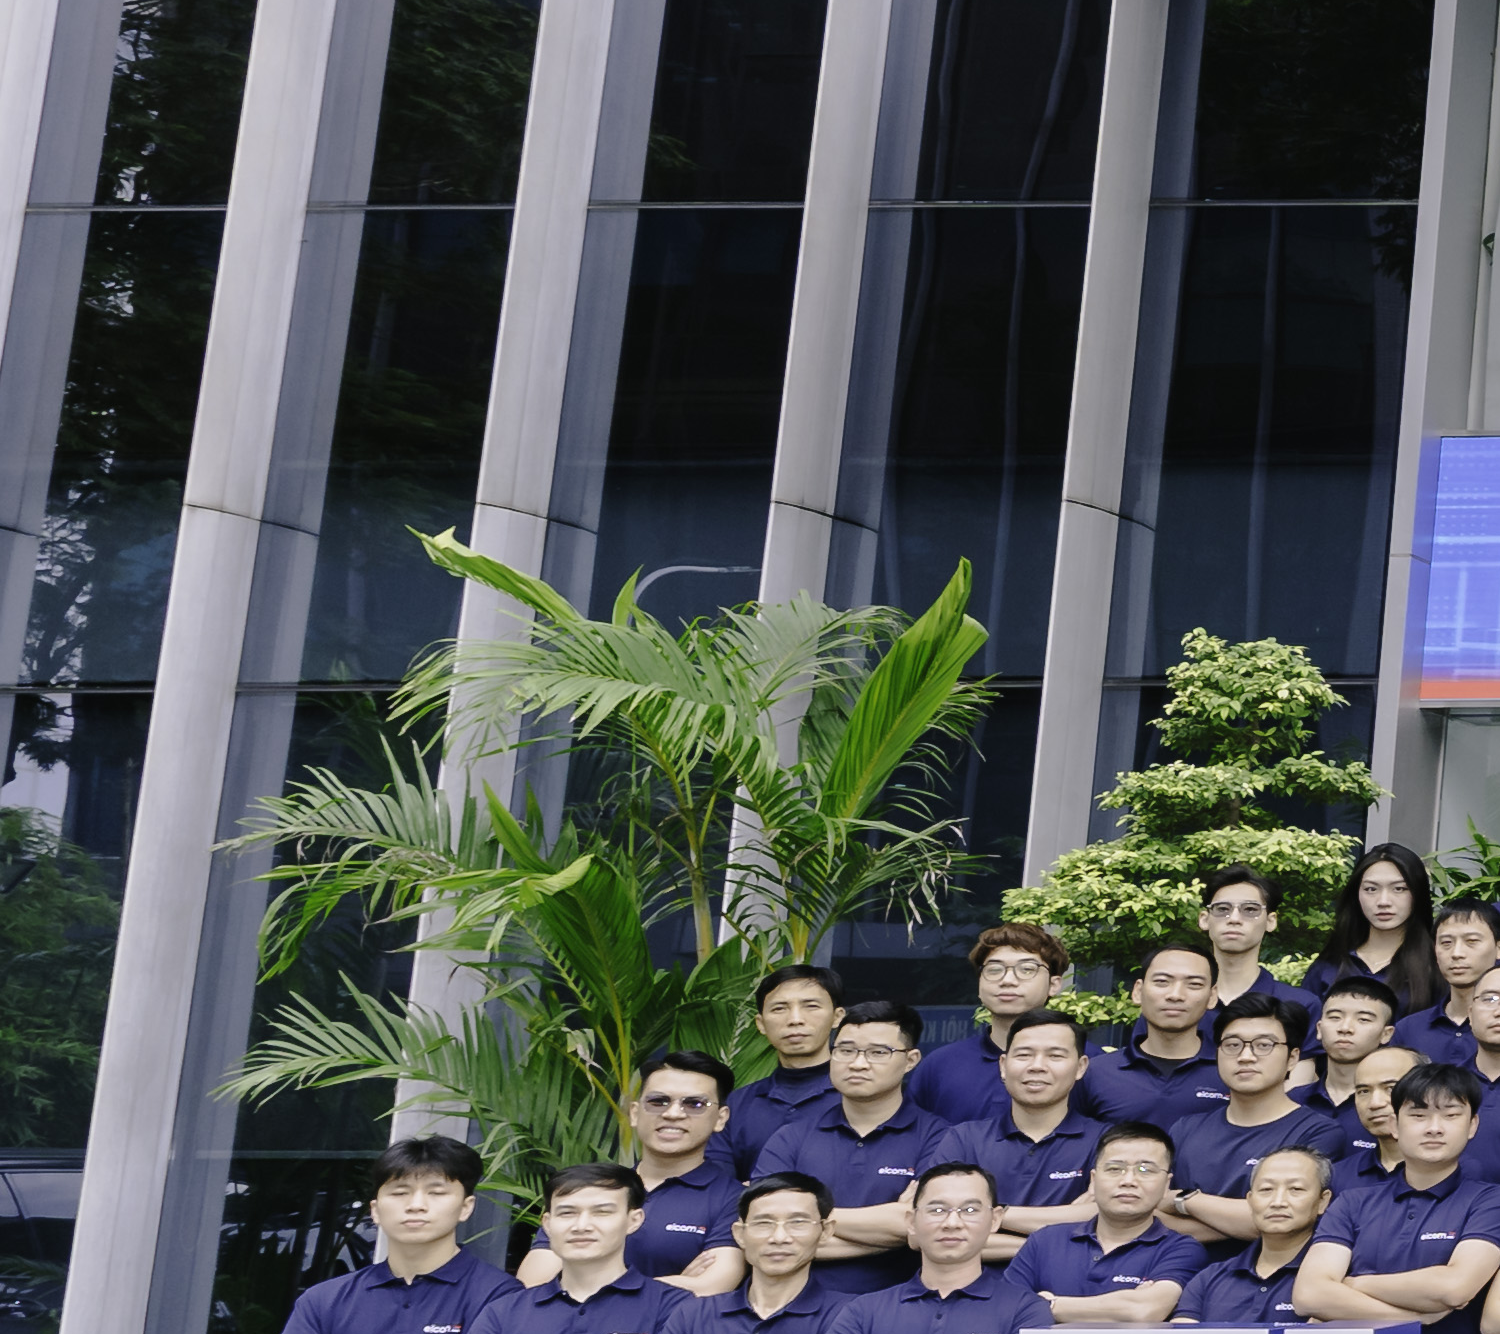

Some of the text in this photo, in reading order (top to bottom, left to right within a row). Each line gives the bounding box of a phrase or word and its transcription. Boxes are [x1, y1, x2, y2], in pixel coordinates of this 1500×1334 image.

[1195, 1090, 1223, 1100] elcom
[877, 1167, 908, 1176] elcom
[665, 1223, 698, 1233] elcom
[1111, 1274, 1141, 1283] elcom
[1274, 1302, 1295, 1311] elco
